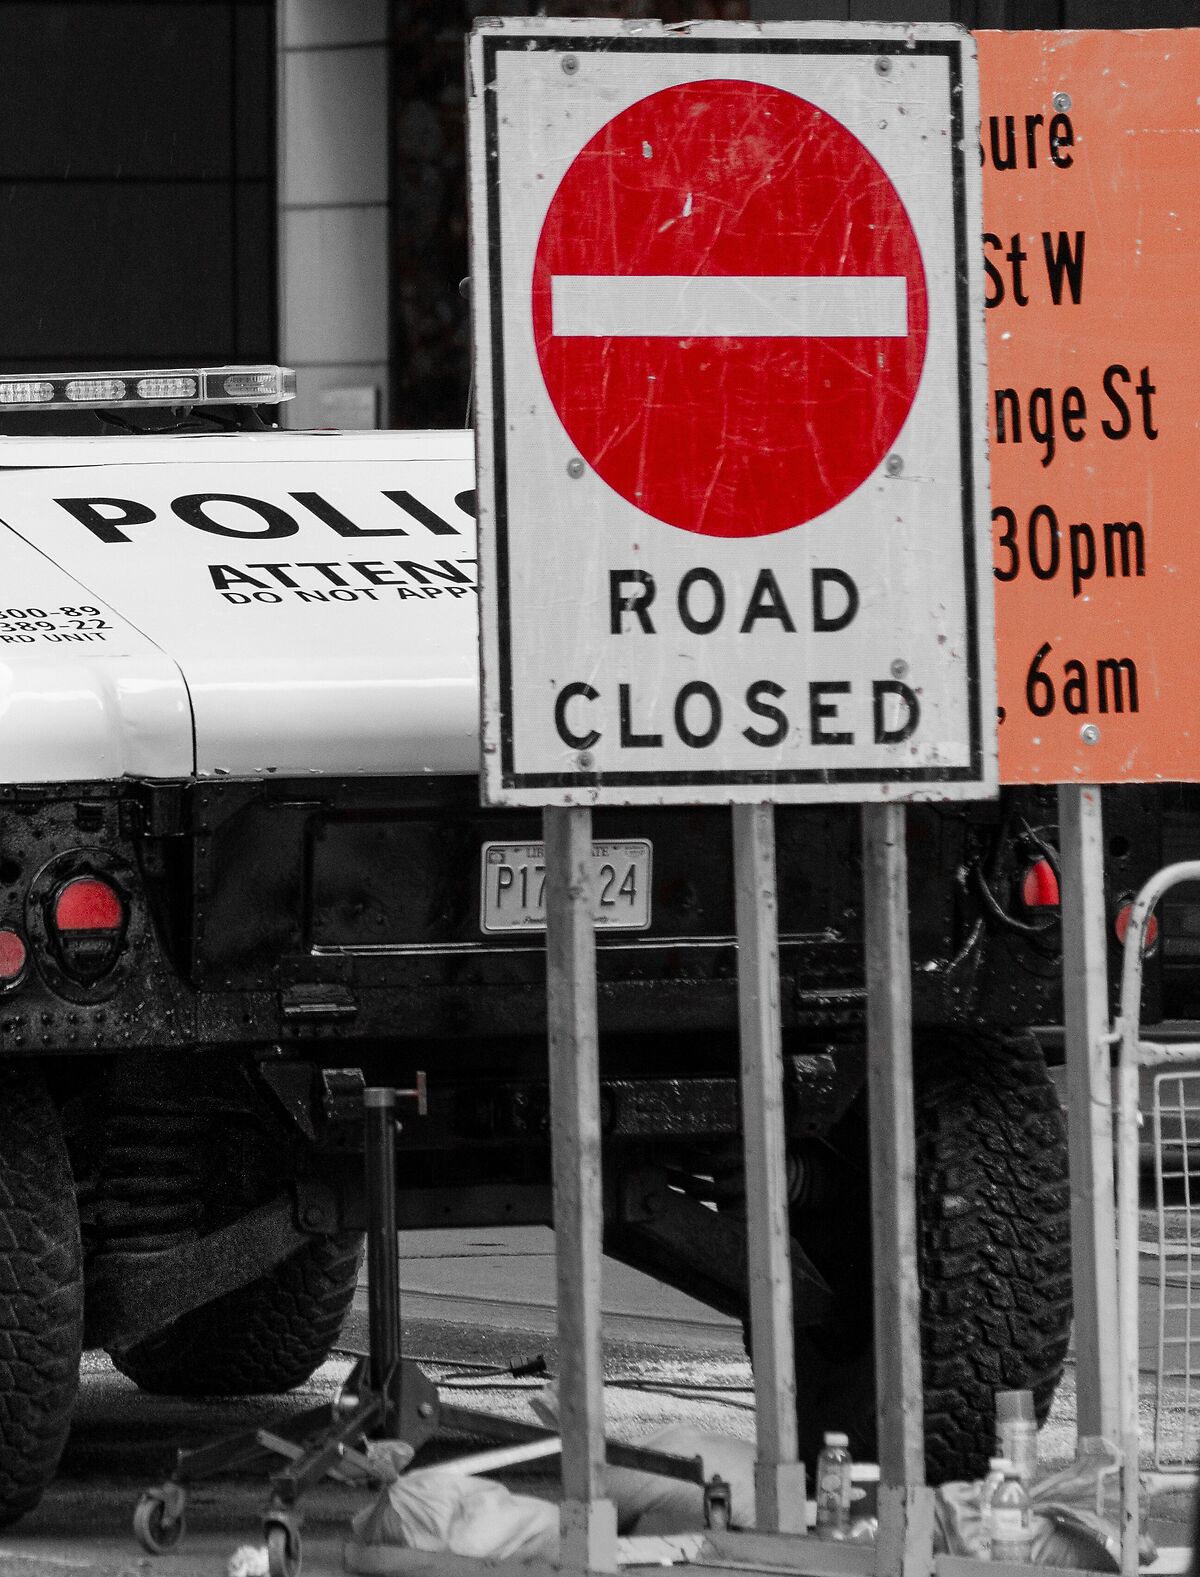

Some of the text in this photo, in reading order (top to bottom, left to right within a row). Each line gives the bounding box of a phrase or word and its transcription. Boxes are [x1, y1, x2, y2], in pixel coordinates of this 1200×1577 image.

[979, 113, 1074, 171] ure
[982, 231, 1086, 308] St W
[1101, 364, 1158, 441] St
[991, 505, 1146, 598] 30pm
[221, 586, 477, 605] DO NOT APP
[608, 567, 860, 635] ROAD
[0, 632, 107, 643] RD UNIT
[555, 679, 921, 749] CLOSED
[1026, 642, 1140, 717] 6am
